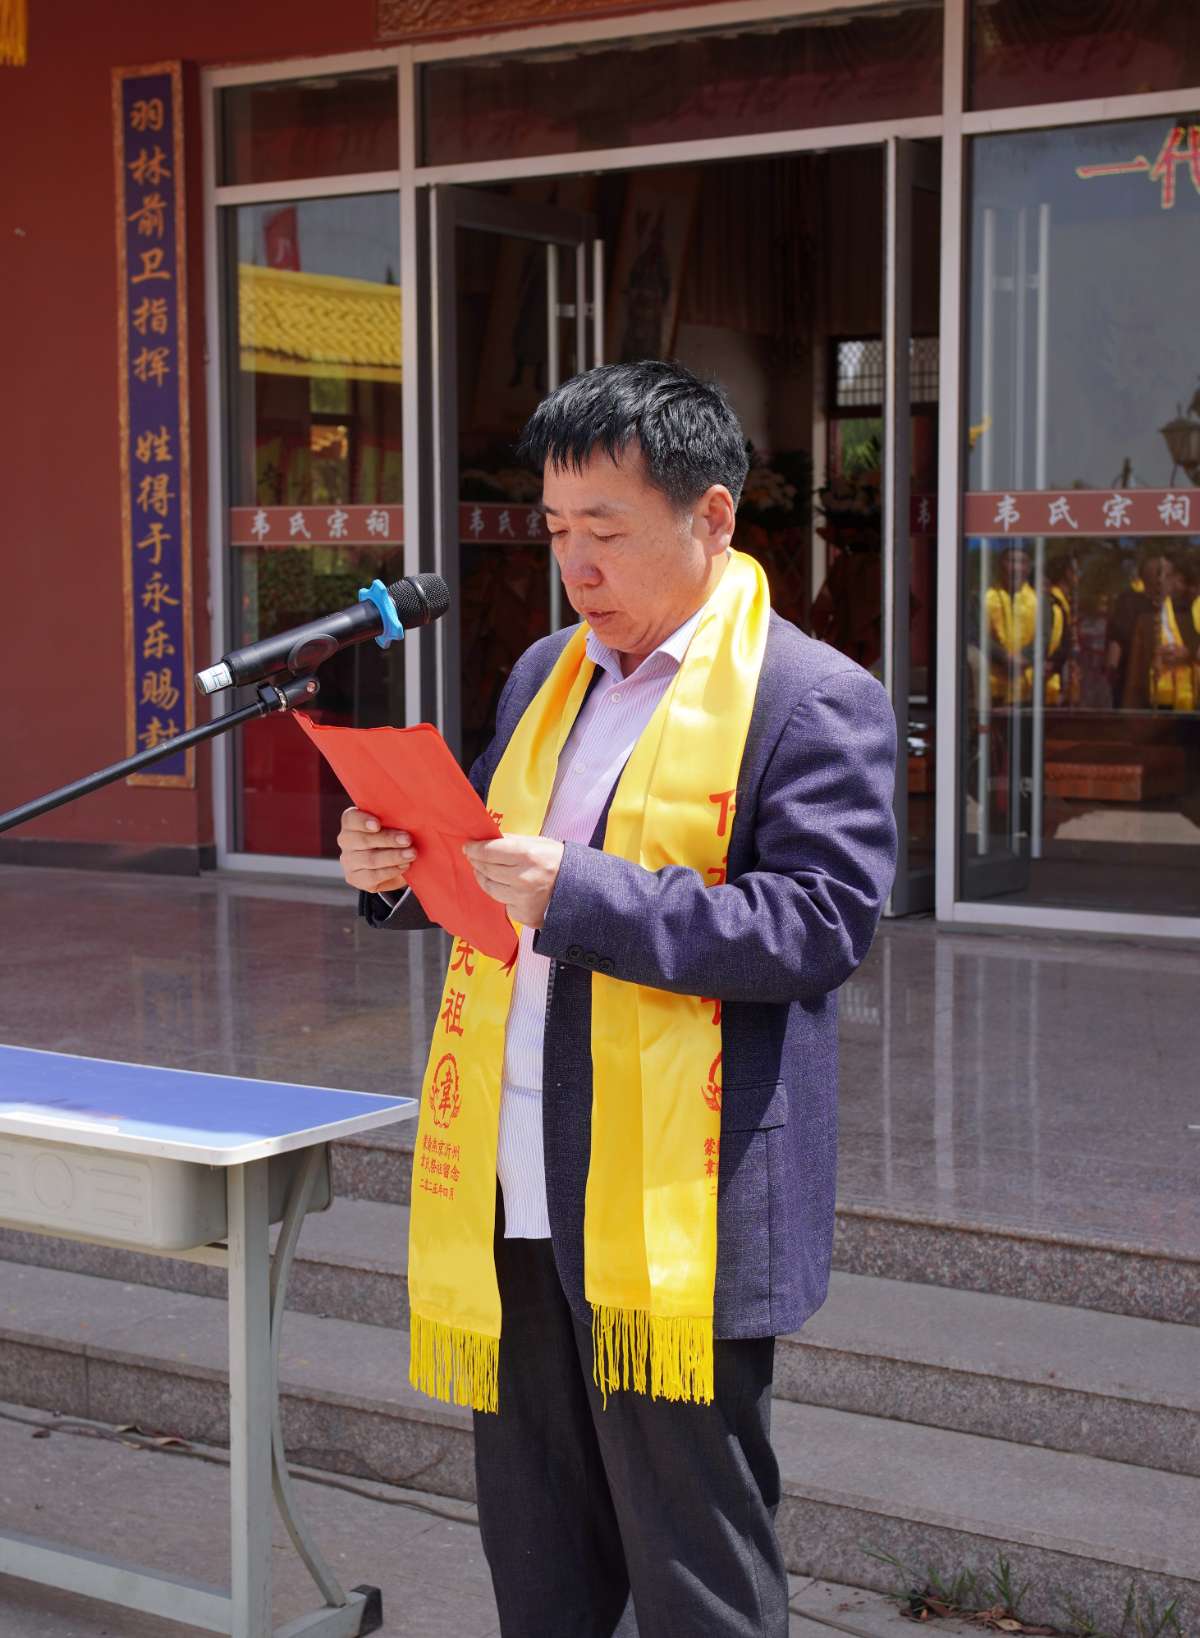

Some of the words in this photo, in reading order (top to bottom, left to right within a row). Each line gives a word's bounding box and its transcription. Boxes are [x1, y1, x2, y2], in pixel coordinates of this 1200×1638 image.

[128, 98, 171, 387] 羽林前卫指挥
[250, 509, 390, 541] 韦氏宗祠
[993, 494, 1190, 531] 韦氏宗祠
